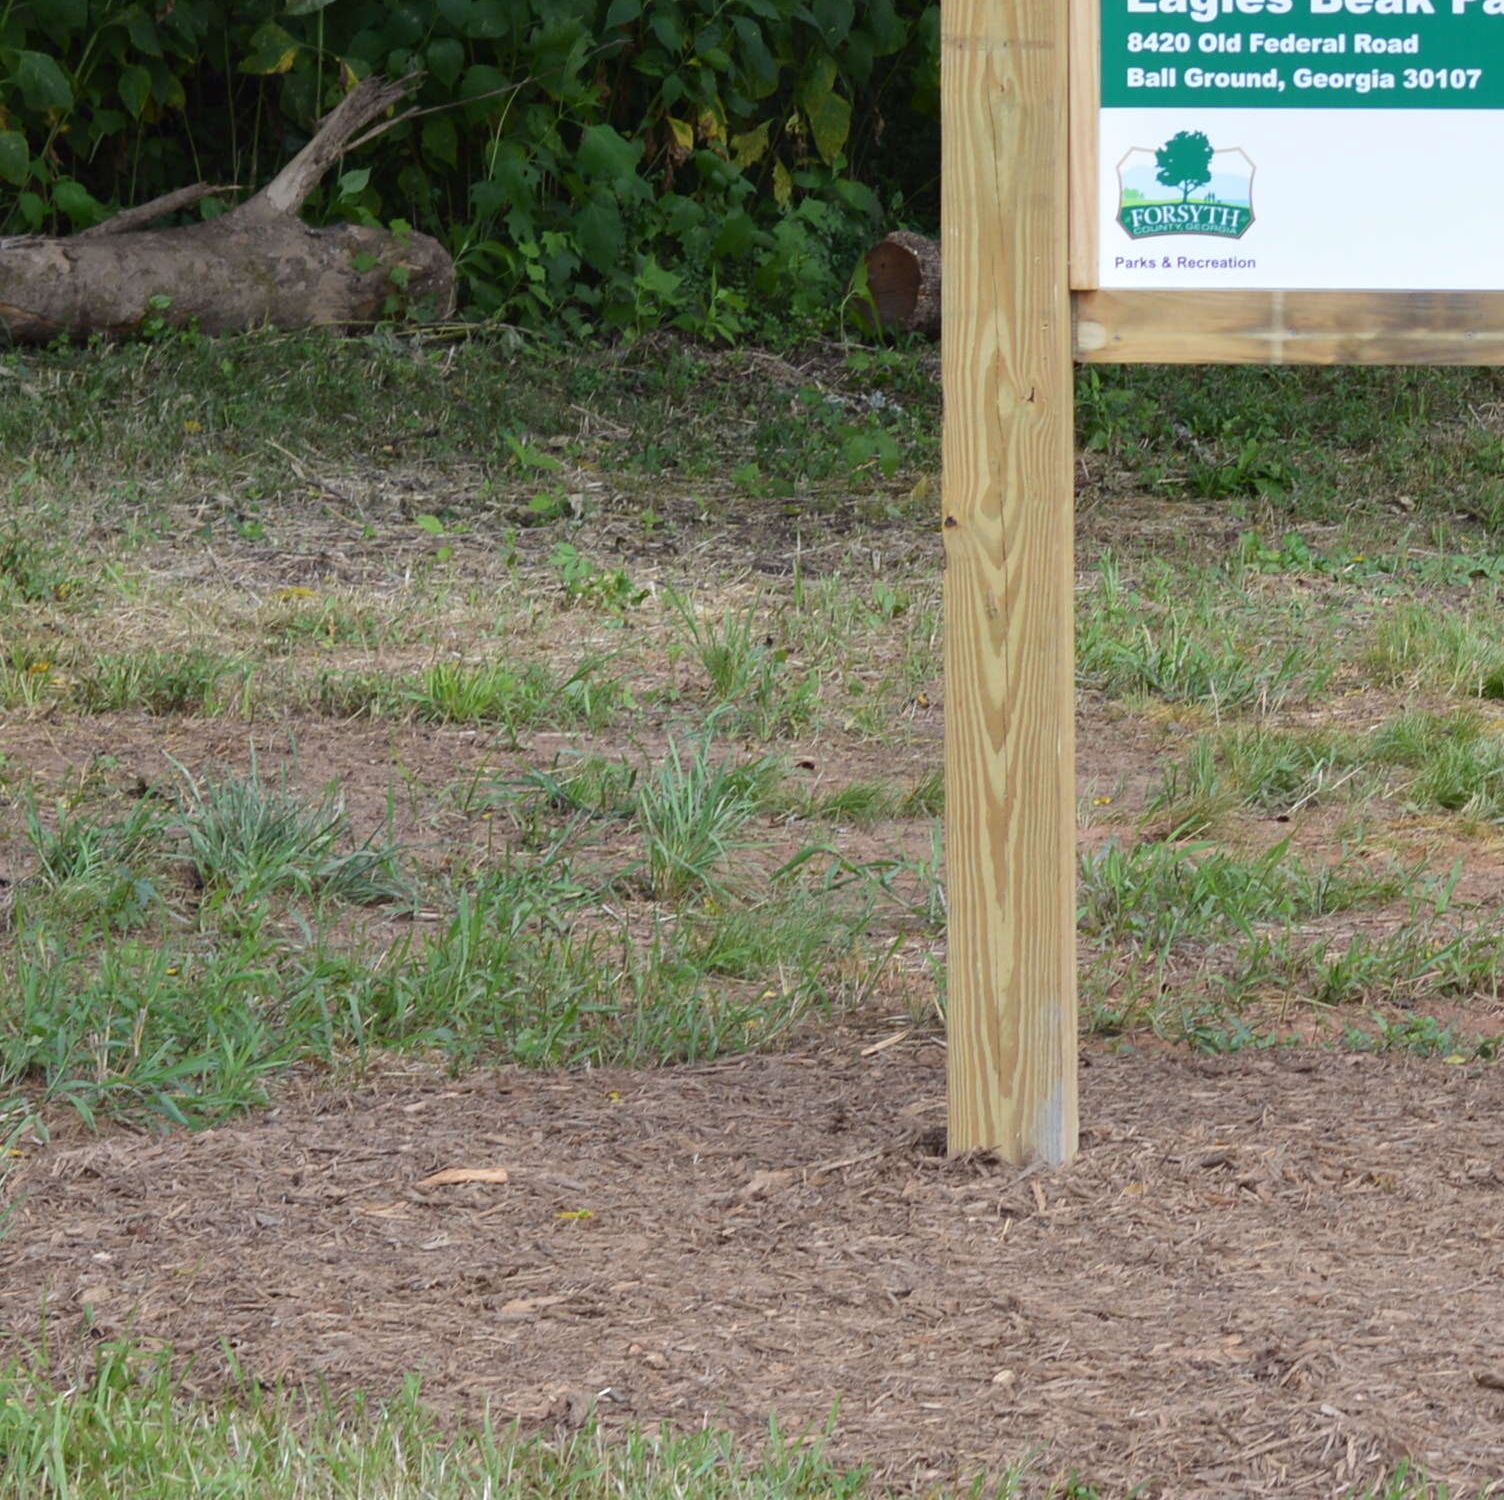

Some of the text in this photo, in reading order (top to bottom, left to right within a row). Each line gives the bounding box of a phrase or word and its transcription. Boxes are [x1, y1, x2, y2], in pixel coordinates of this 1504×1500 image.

[1127, 32, 1419, 54] 8420 Old Federal Road
[1126, 67, 1482, 93] Ball Ground, Georgia 30107
[1130, 203, 1241, 228] FORSYTH
[1185, 222, 1238, 235] GEORGIA
[1115, 256, 1257, 269] Parks & Recreation
